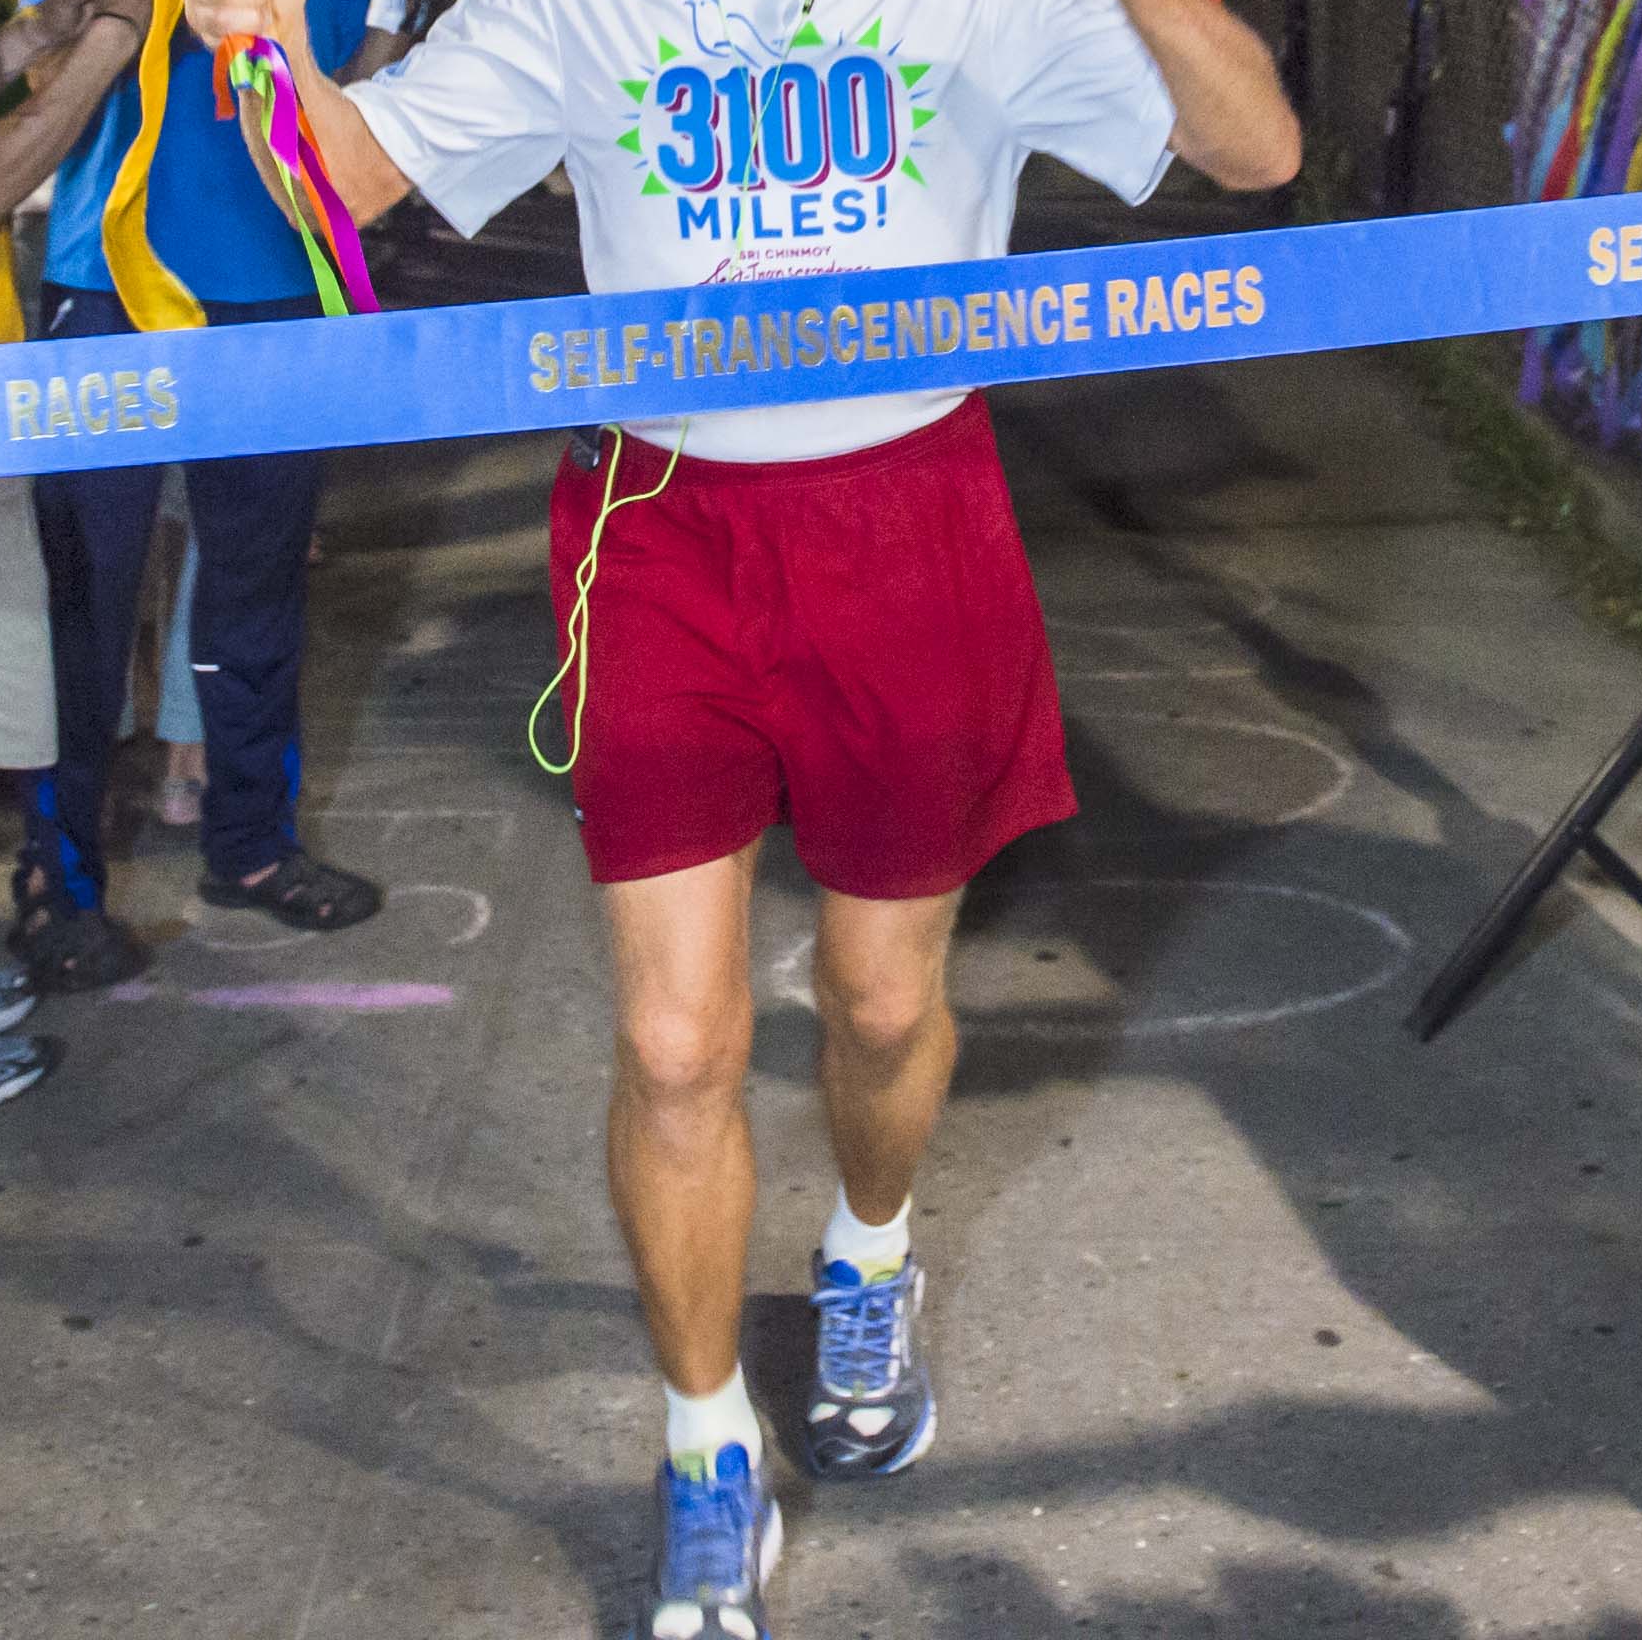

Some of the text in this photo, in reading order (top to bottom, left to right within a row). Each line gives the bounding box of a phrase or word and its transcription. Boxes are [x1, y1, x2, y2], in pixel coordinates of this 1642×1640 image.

[656, 55, 897, 193] 3100
[676, 184, 888, 241] MILES!
[739, 245, 834, 261] SRI CHINMOY
[528, 264, 1266, 394] SELF-TRANSCENDENCE RACES
[5, 364, 180, 443] RACES
